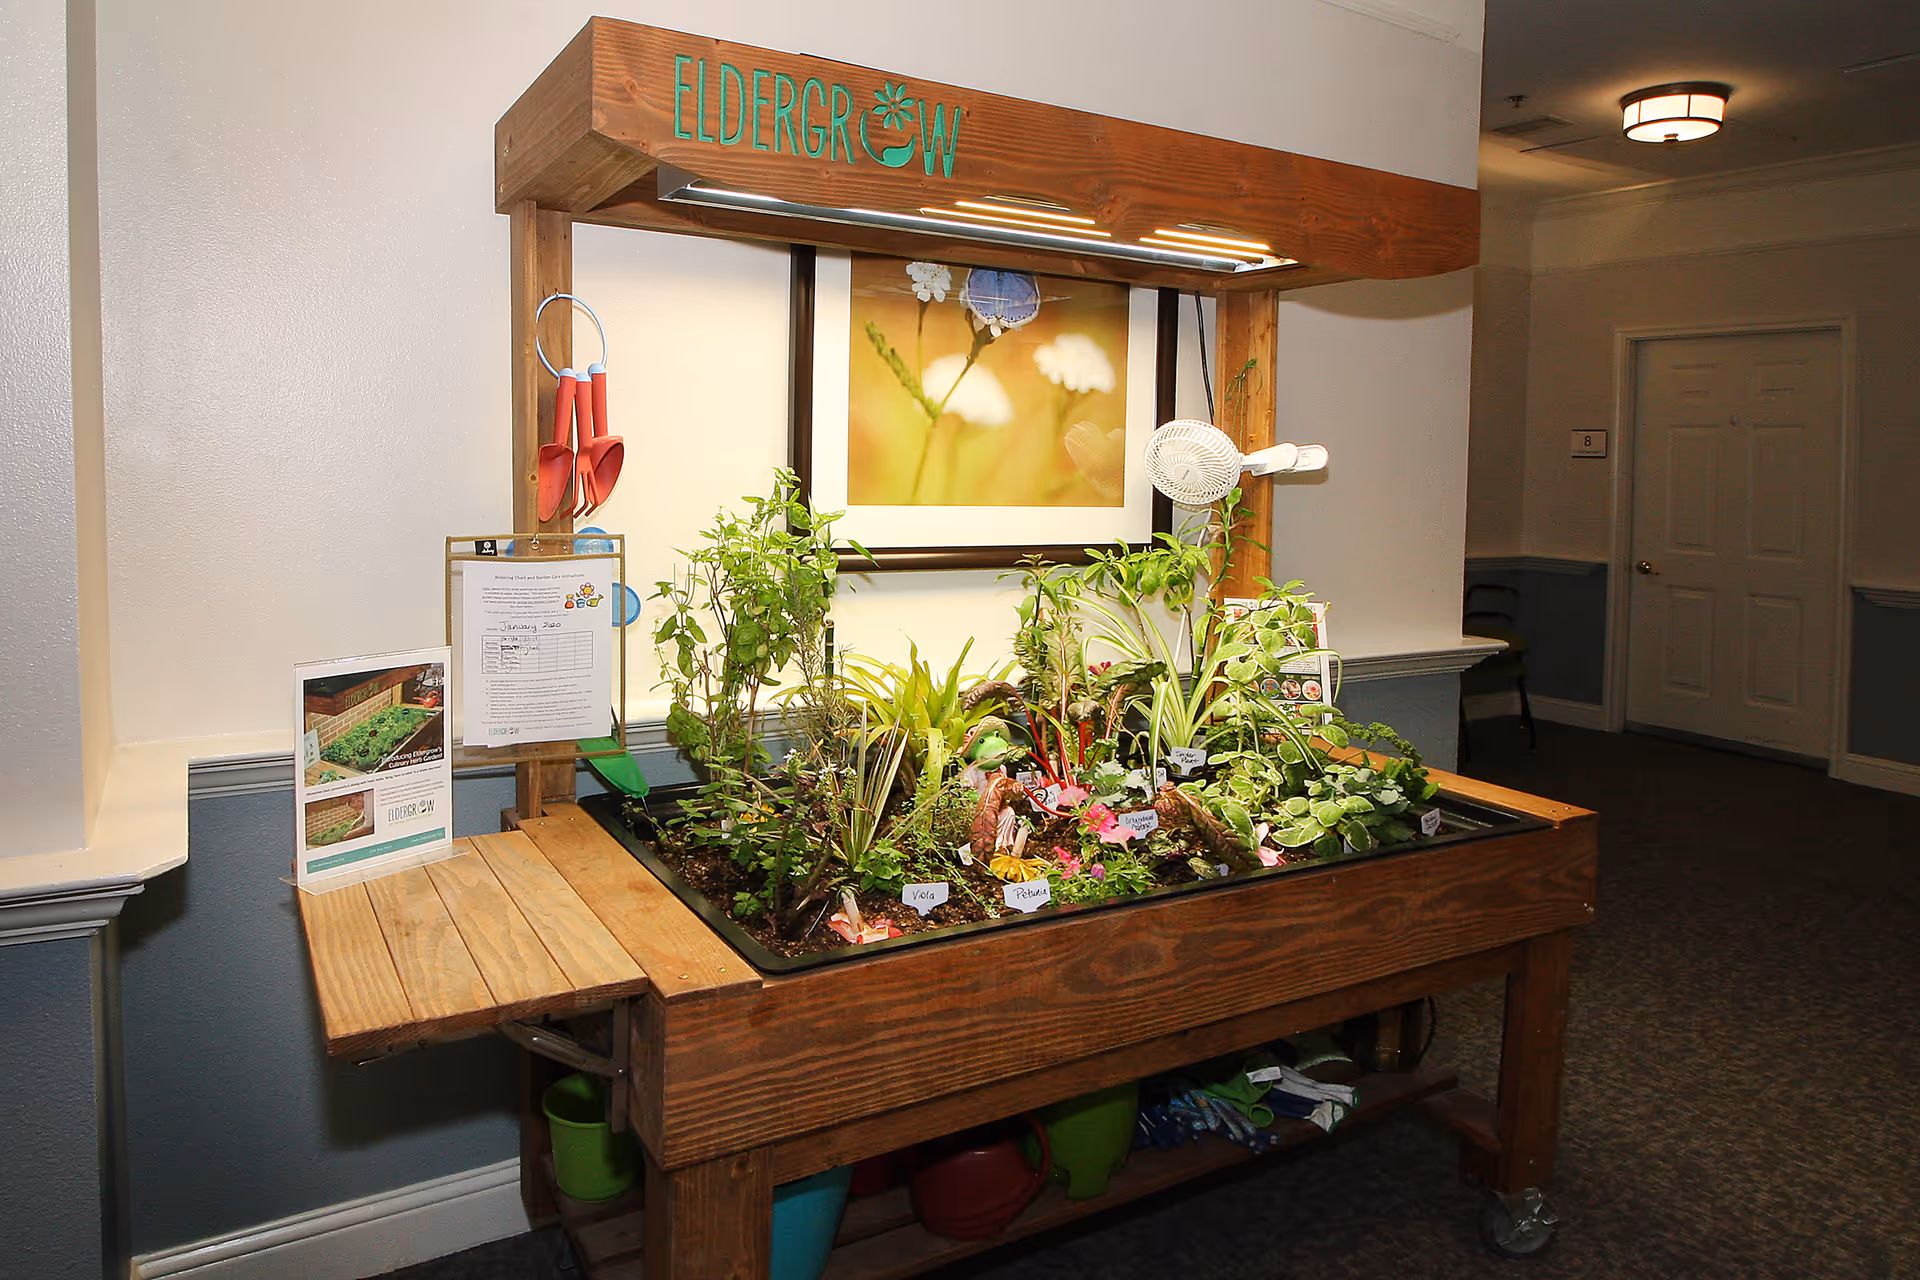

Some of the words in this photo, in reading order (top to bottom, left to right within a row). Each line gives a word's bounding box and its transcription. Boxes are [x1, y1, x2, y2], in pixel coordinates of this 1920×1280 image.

[674, 53, 962, 179] ELDERGROW
[1583, 435, 1592, 447] 8
[499, 620, 538, 633] January
[912, 889, 936, 901] Viola
[1013, 886, 1048, 900] Petunia
